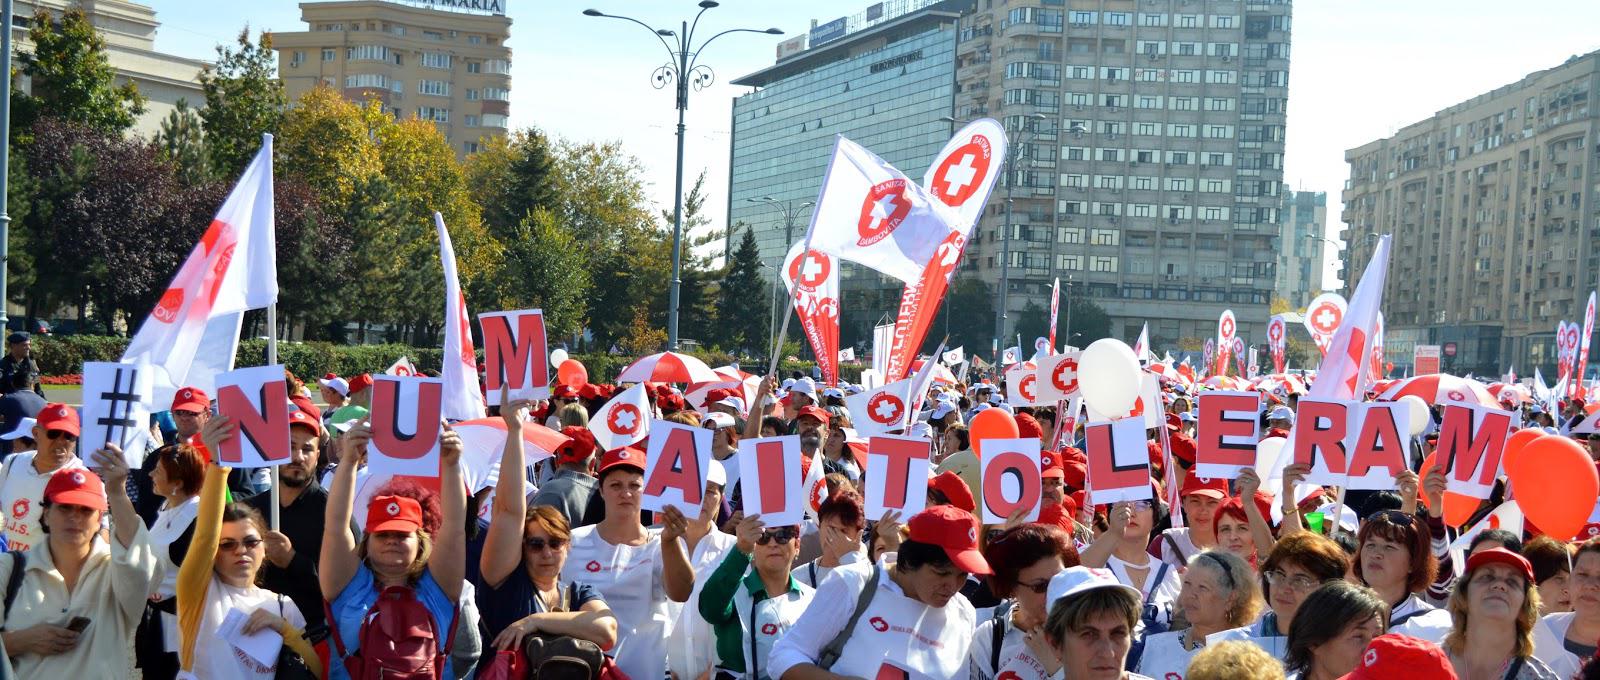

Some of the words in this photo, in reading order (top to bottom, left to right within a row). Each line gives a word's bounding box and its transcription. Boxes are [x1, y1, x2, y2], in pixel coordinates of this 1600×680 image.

[480, 313, 547, 390] M
[217, 380, 291, 463] N
[370, 380, 443, 460] U
[1196, 394, 1259, 467] E
[1435, 405, 1511, 486] M
[643, 429, 703, 505] A
[756, 441, 785, 514] I
[868, 436, 930, 509] T
[983, 452, 1041, 519] O
[1086, 424, 1150, 491] L
